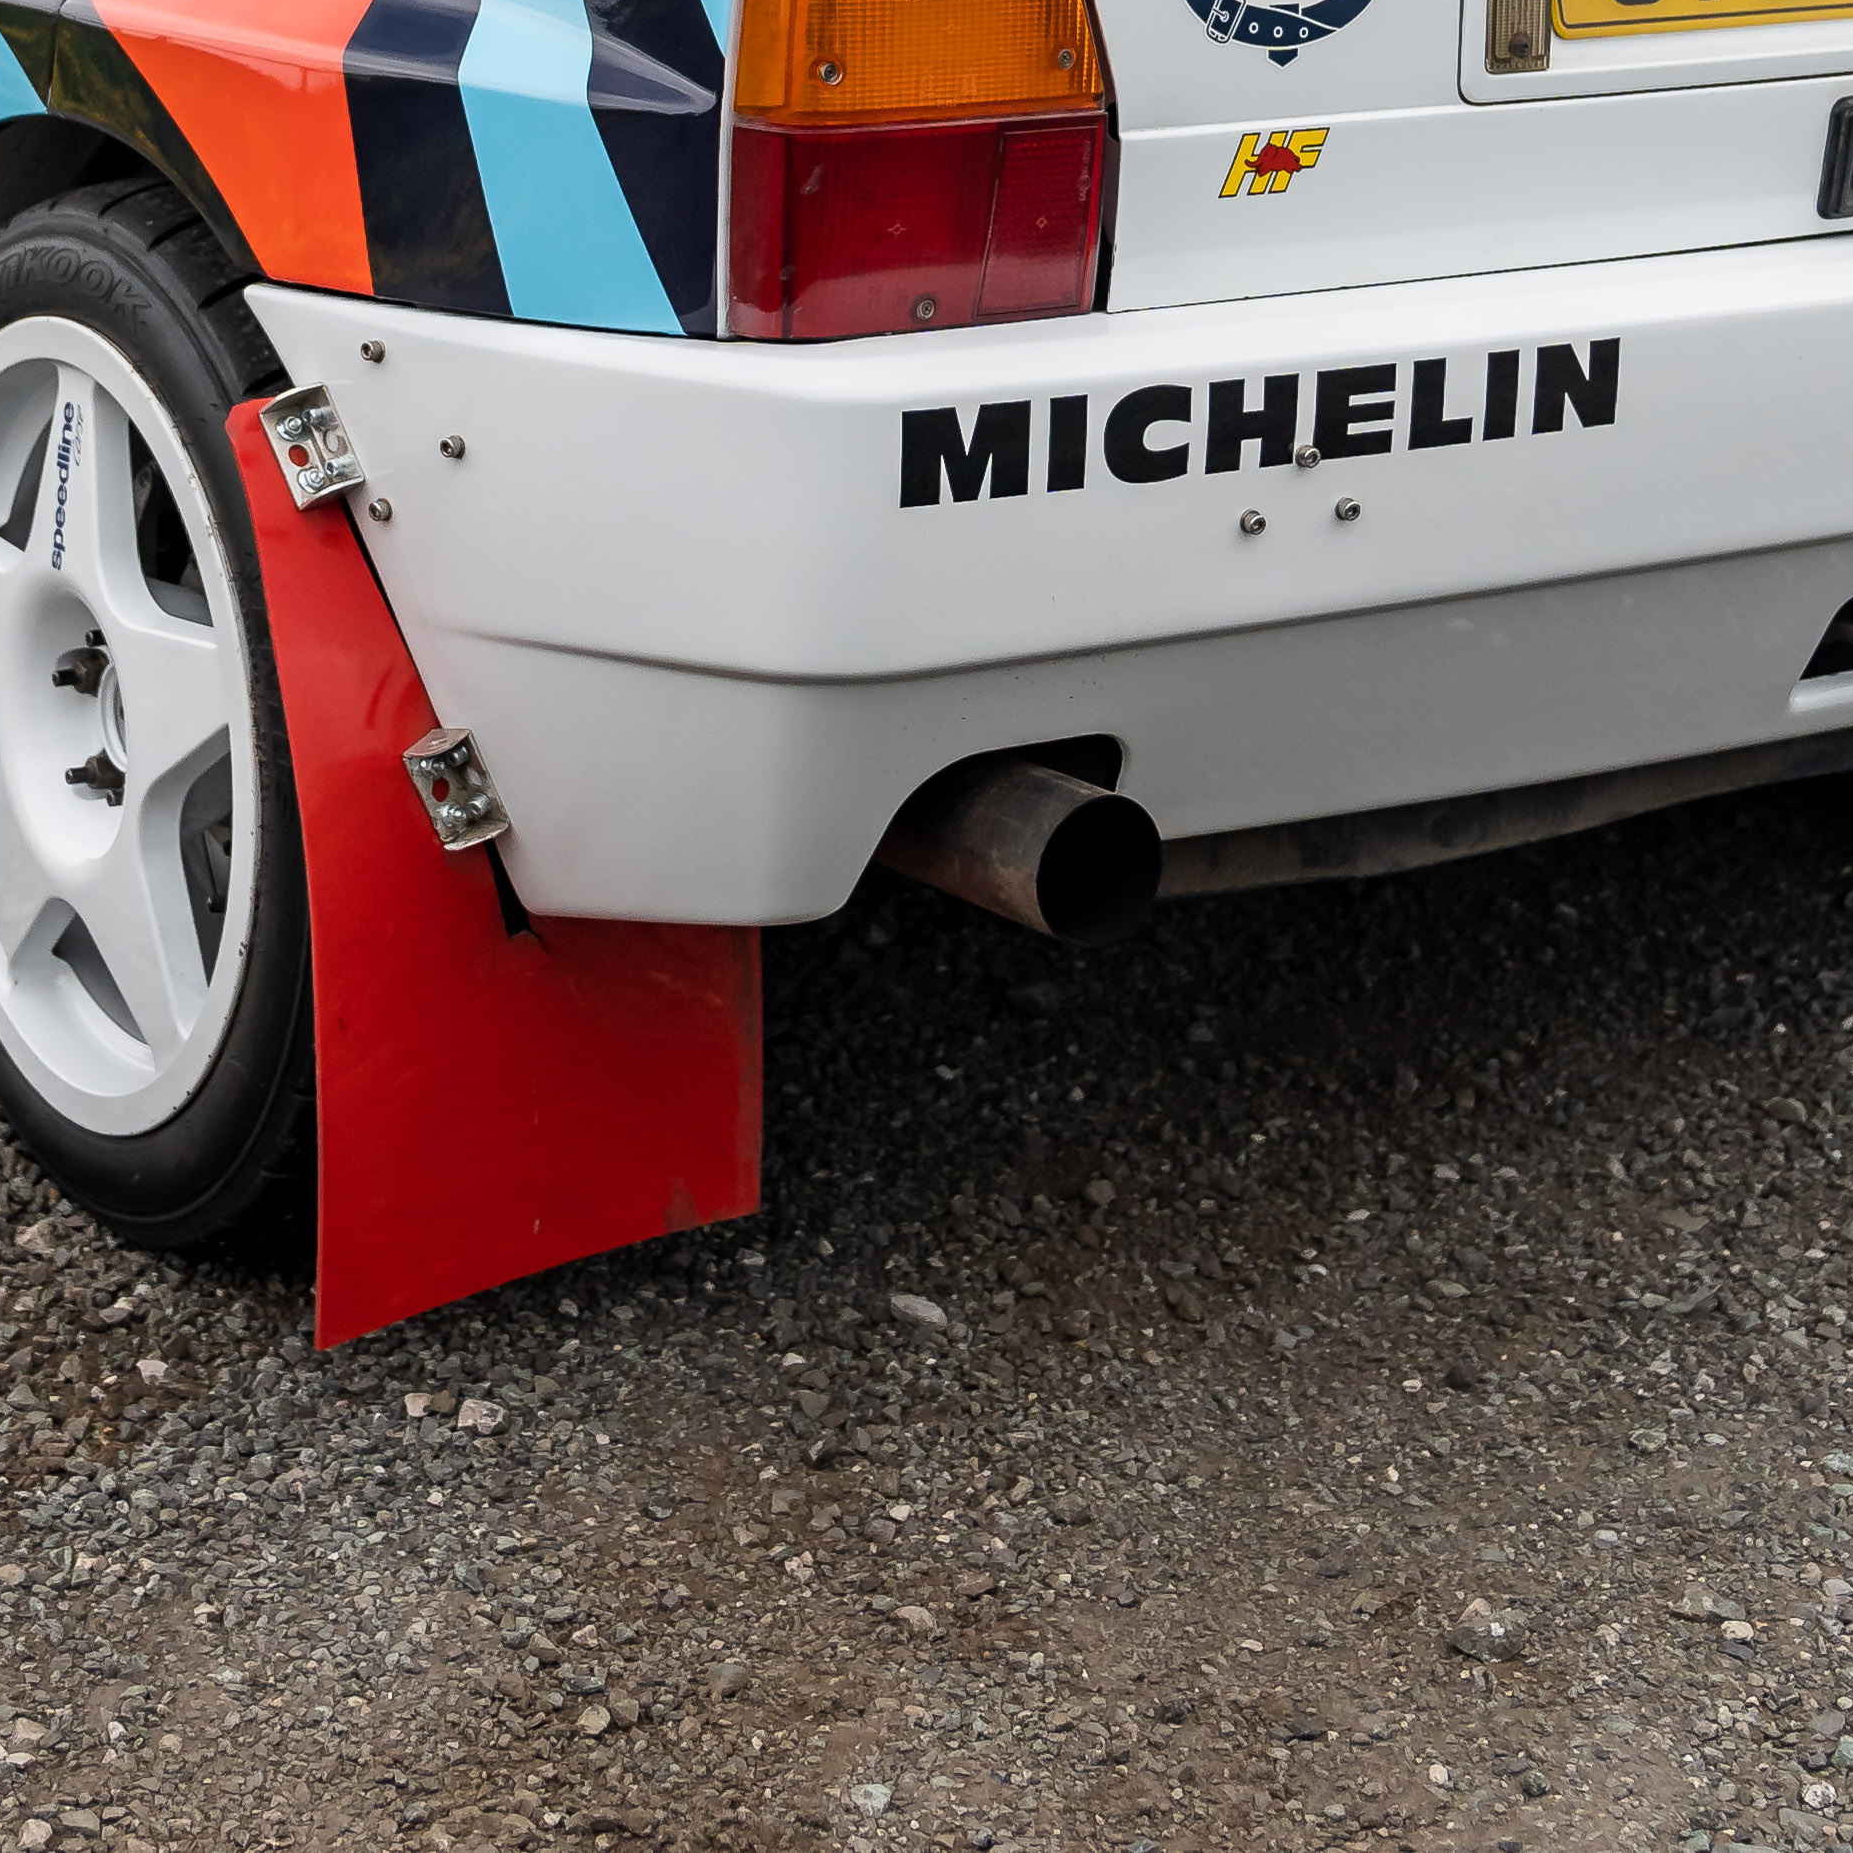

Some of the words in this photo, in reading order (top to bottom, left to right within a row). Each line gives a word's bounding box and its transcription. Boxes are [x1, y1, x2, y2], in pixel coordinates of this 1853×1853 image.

[1218, 126, 1331, 199] HF
[51, 401, 75, 571] speedline
[899, 337, 1622, 509] MICHELIN
